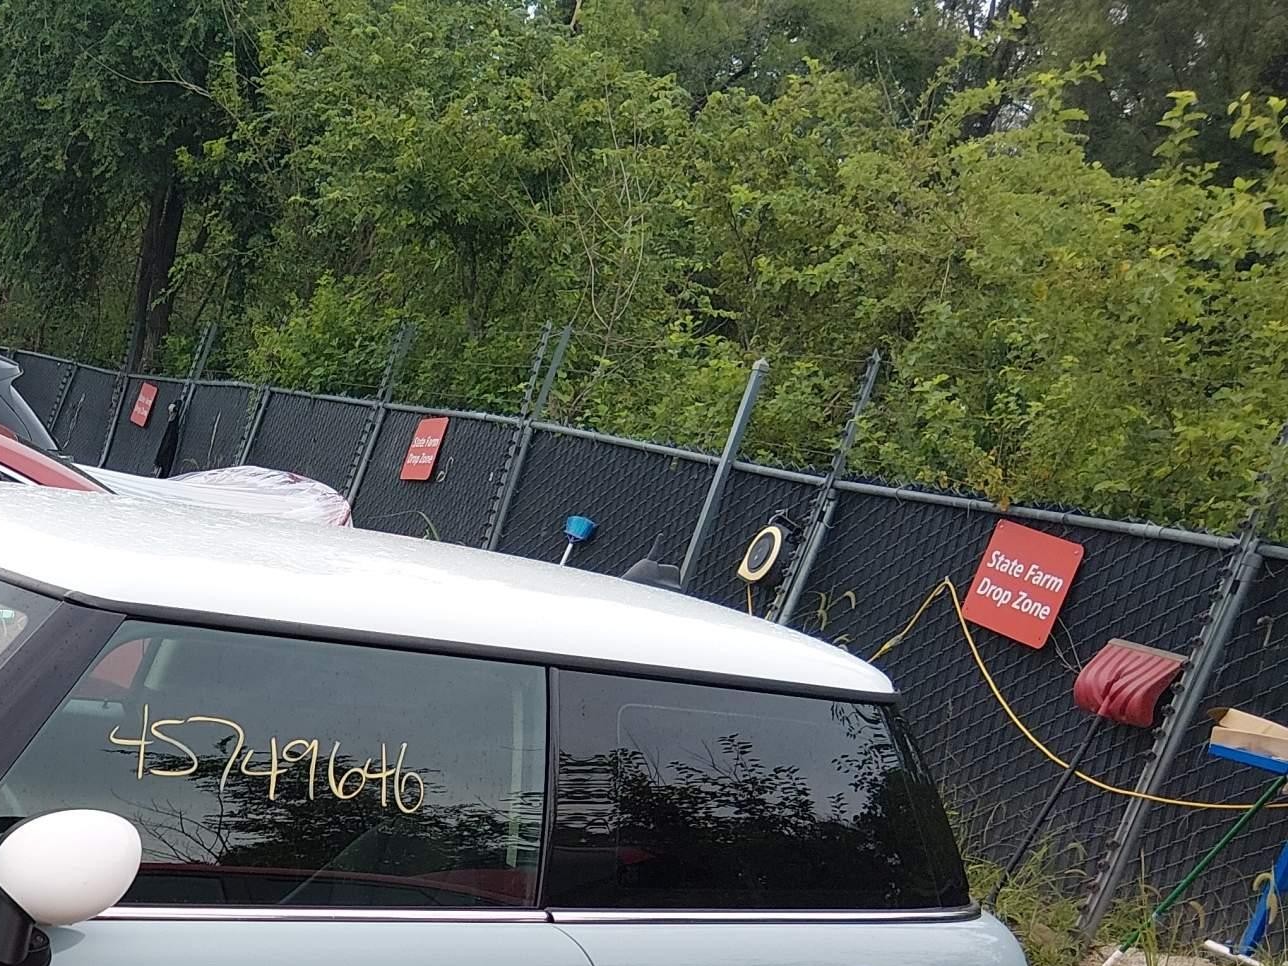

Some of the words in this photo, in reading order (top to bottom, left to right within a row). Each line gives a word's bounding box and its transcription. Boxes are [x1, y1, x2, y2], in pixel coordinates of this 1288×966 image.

[986, 550, 1025, 578] State
[1023, 564, 1064, 593] Farm
[976, 577, 1012, 608] Drop
[1011, 591, 1051, 620] Zone
[109, 703, 425, 815] 45749646
